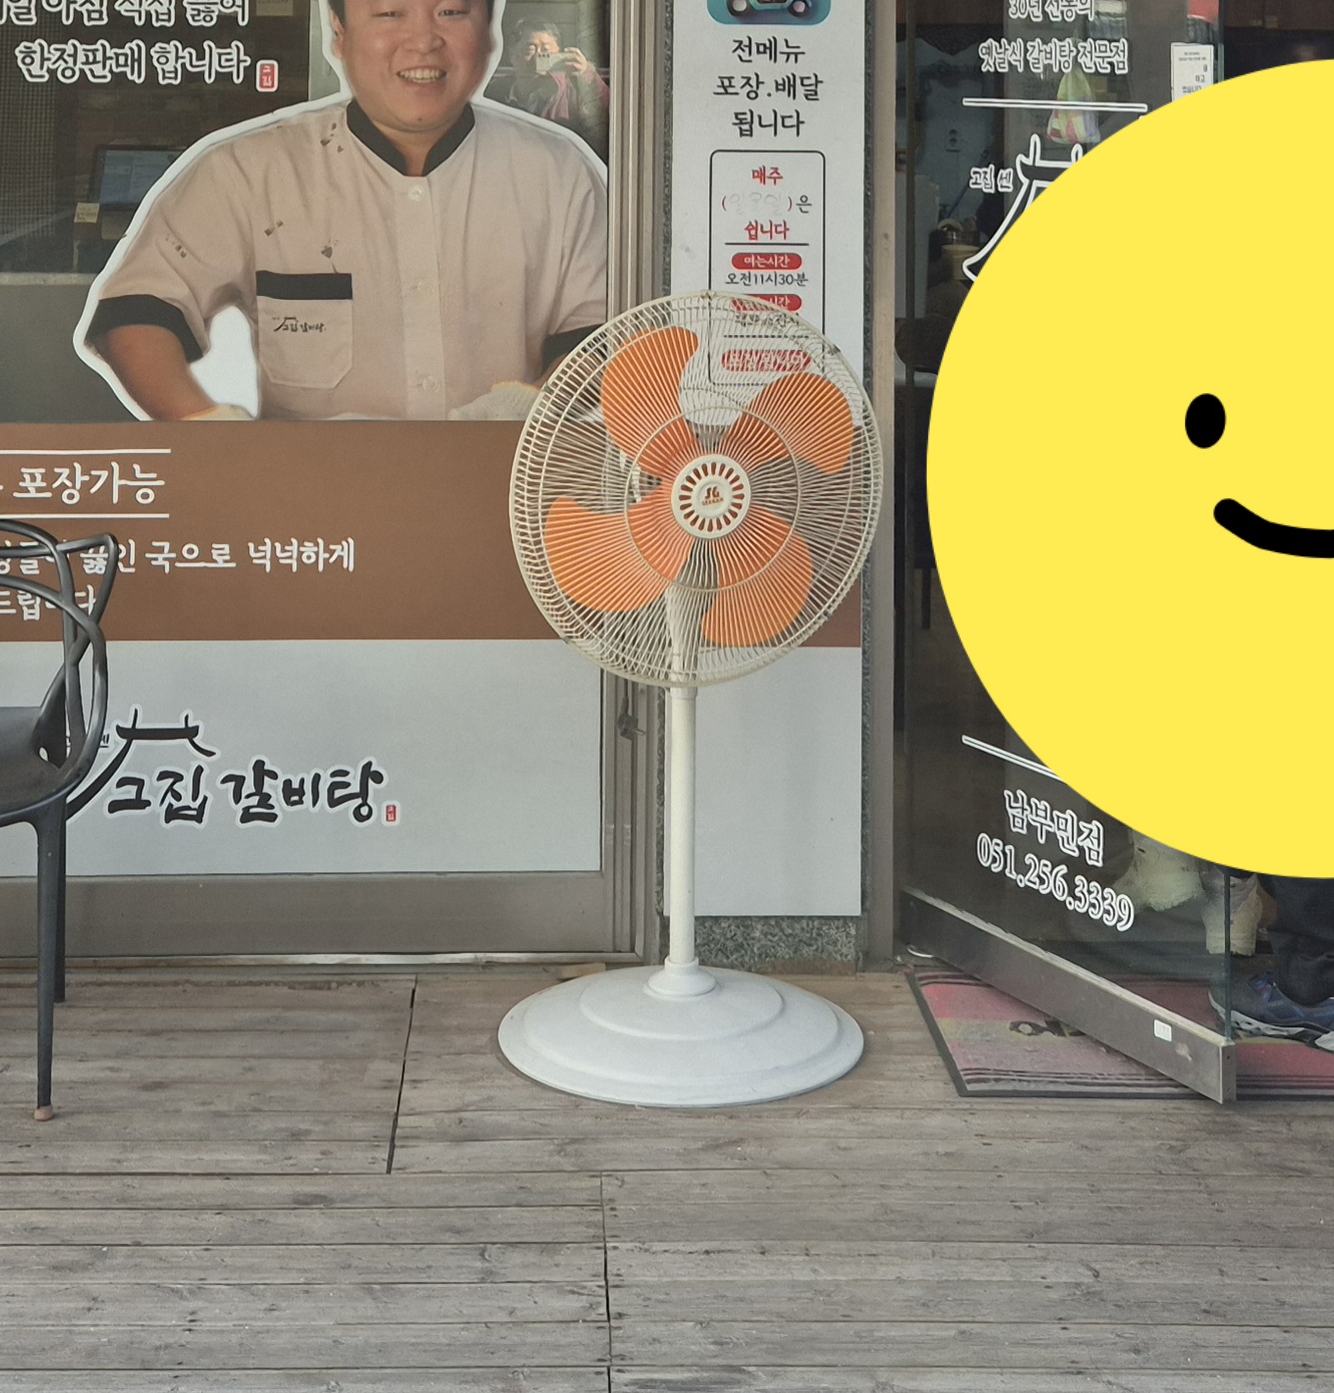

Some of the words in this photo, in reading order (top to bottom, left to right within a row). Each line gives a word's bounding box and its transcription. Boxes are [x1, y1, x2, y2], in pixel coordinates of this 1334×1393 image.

[16, 40, 146, 84] 한정판매
[151, 40, 251, 84] 합니다
[731, 35, 807, 64] 전메뉴
[978, 38, 1024, 73] 옛날식
[1026, 38, 1076, 74] 갈비탕
[1077, 38, 1129, 75] 전문점
[713, 72, 824, 102] 포장.배달
[731, 108, 806, 138] 됩니다
[751, 165, 784, 186] 매주
[970, 164, 995, 193] 고집
[998, 168, 1014, 193] 센
[744, 219, 790, 241] 쉽니다
[744, 254, 791, 269] 여는시간
[725, 271, 809, 288] 오전11시30분
[13, 462, 166, 505] 포장가능
[144, 540, 237, 574] 국으로
[247, 537, 356, 574] 넉넉하게
[107, 763, 208, 825] 그집
[219, 758, 385, 824] 갈비탕
[1004, 789, 1104, 868] 남부민점
[977, 832, 1135, 932] 051.256.3339
